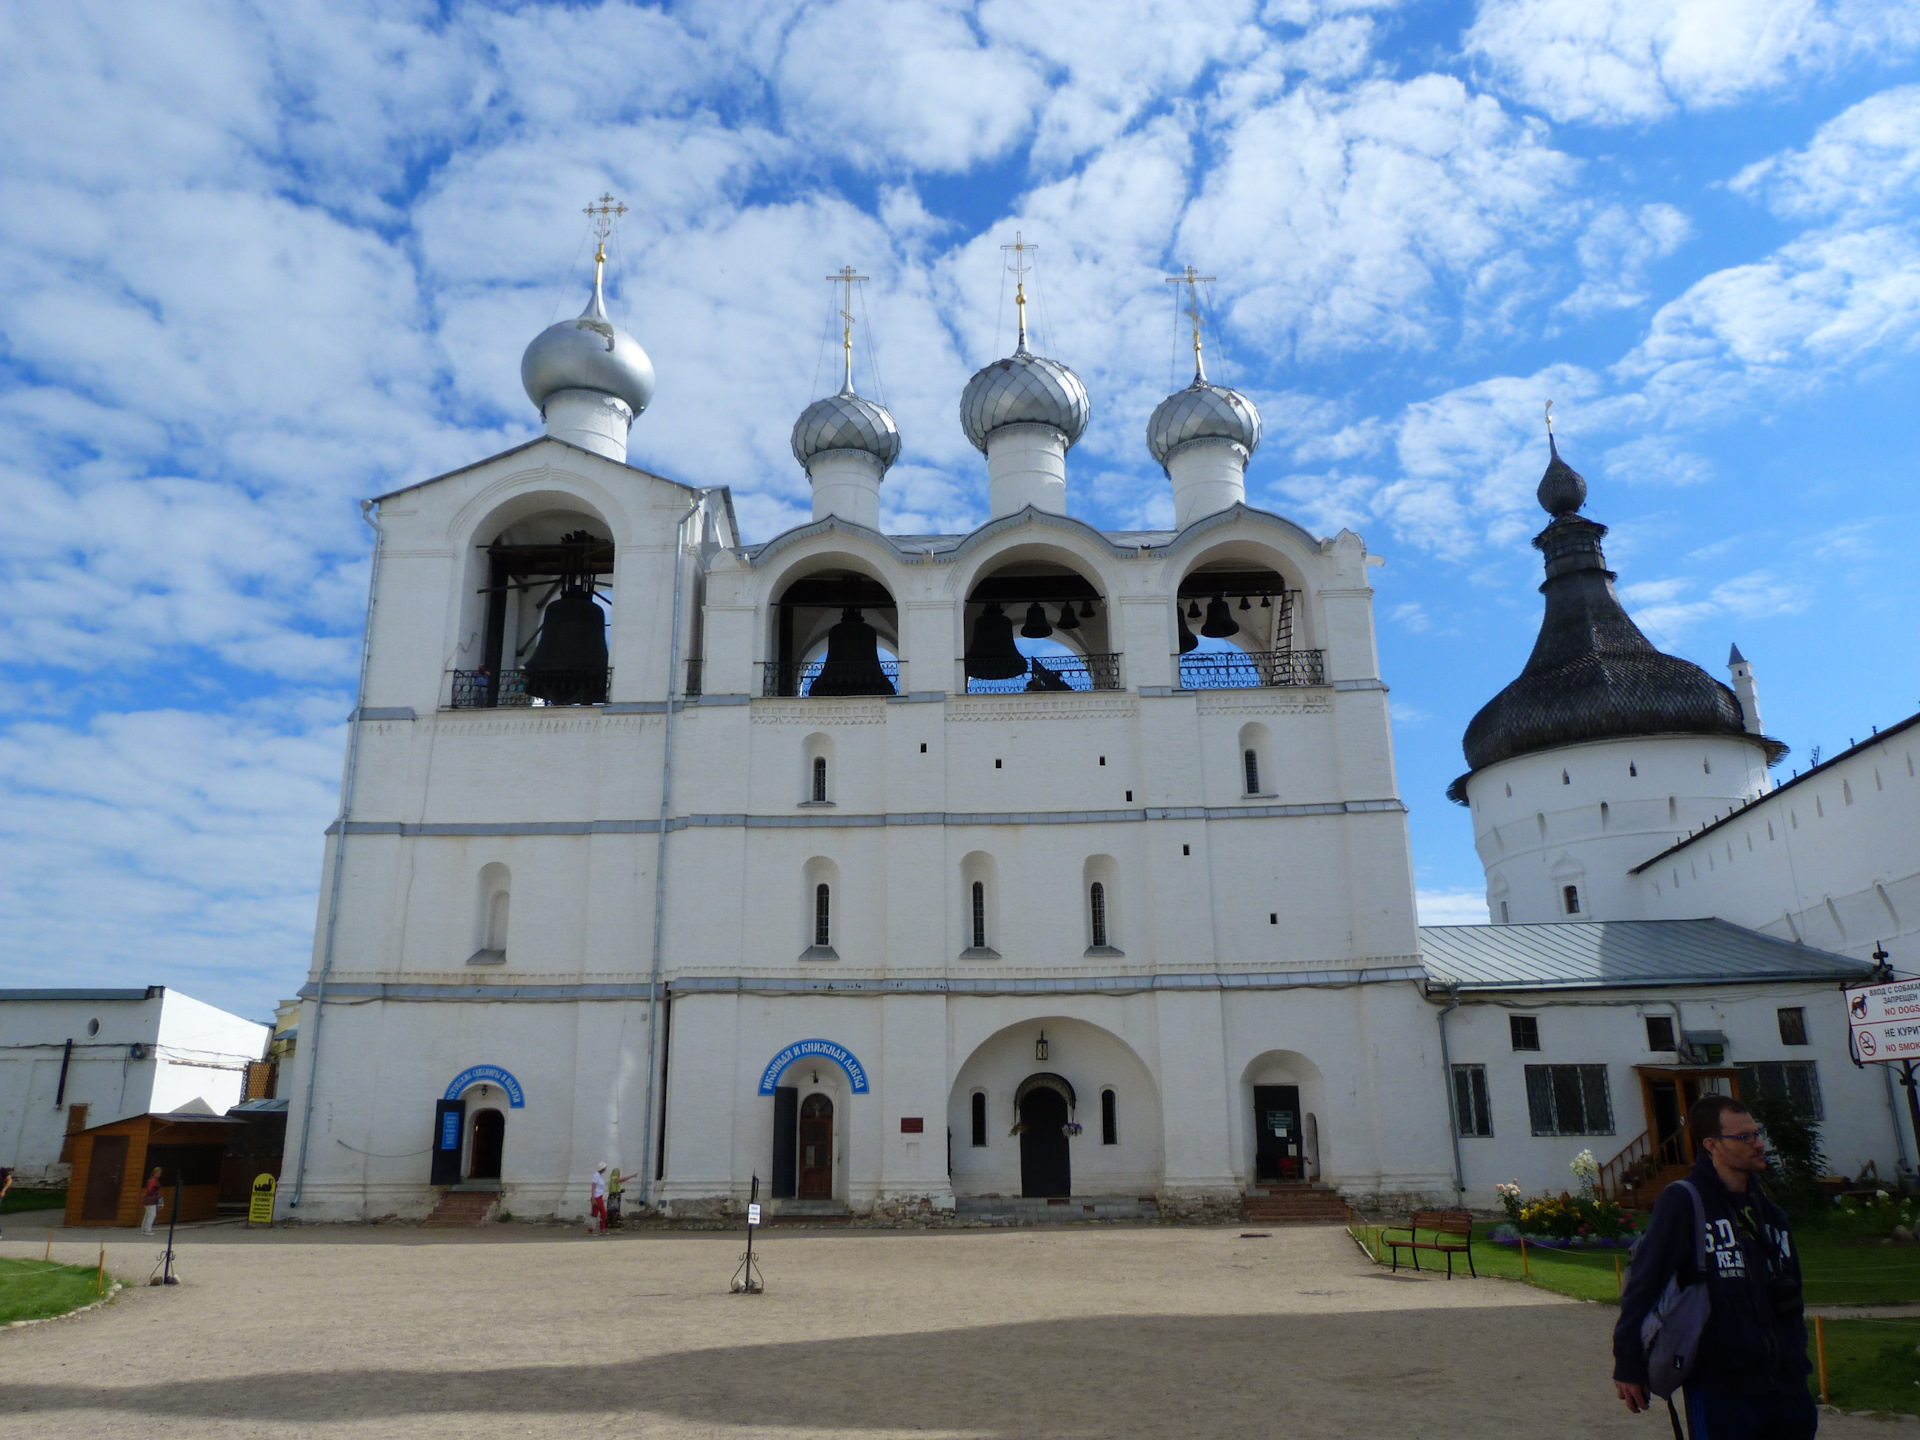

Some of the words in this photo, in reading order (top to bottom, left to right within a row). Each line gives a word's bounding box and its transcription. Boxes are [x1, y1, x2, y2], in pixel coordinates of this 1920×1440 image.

[1869, 988, 1887, 997] ВХОД
[1887, 986, 1893, 994] С
[1882, 993, 1918, 1005] ЗАПРЕЩЕН
[1884, 1008, 1896, 1016] NO
[1884, 1028, 1896, 1038] НЕ
[1885, 1044, 1896, 1052] NO
[762, 1049, 794, 1090] ИКОННАЯ
[793, 1045, 801, 1056] И
[801, 1042, 847, 1061] КНИЖНАЯ
[843, 1058, 865, 1090] ЛАВКА
